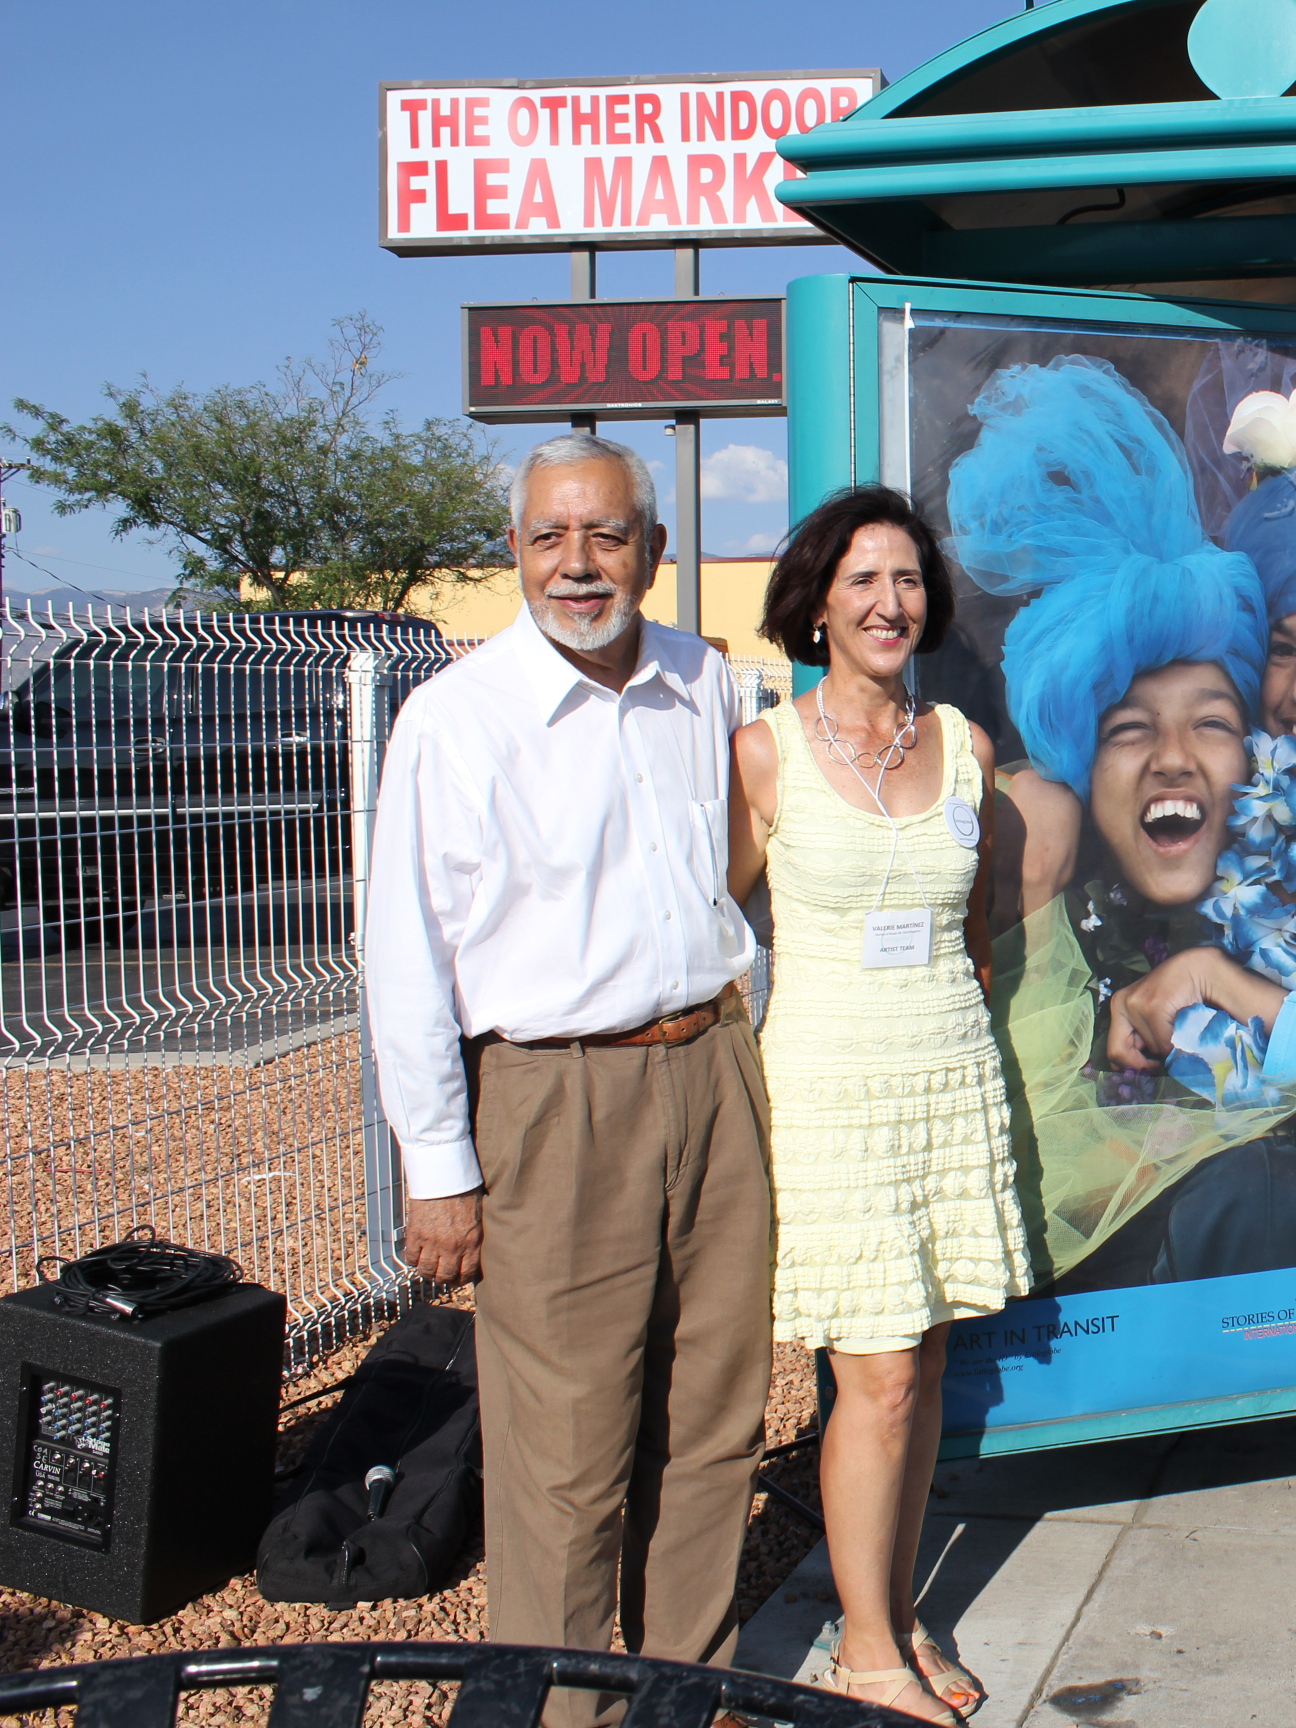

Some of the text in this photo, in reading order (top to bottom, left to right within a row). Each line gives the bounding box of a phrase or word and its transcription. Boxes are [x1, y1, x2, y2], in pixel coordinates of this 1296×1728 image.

[400, 97, 491, 149] THE
[507, 93, 665, 147] OTHER
[396, 157, 561, 233] FLEA
[480, 323, 612, 386] NOW
[953, 1315, 1120, 1351] ART IN TRANSIT
[1221, 1310, 1275, 1329] STORIES
[1277, 1308, 1295, 1320] OF
